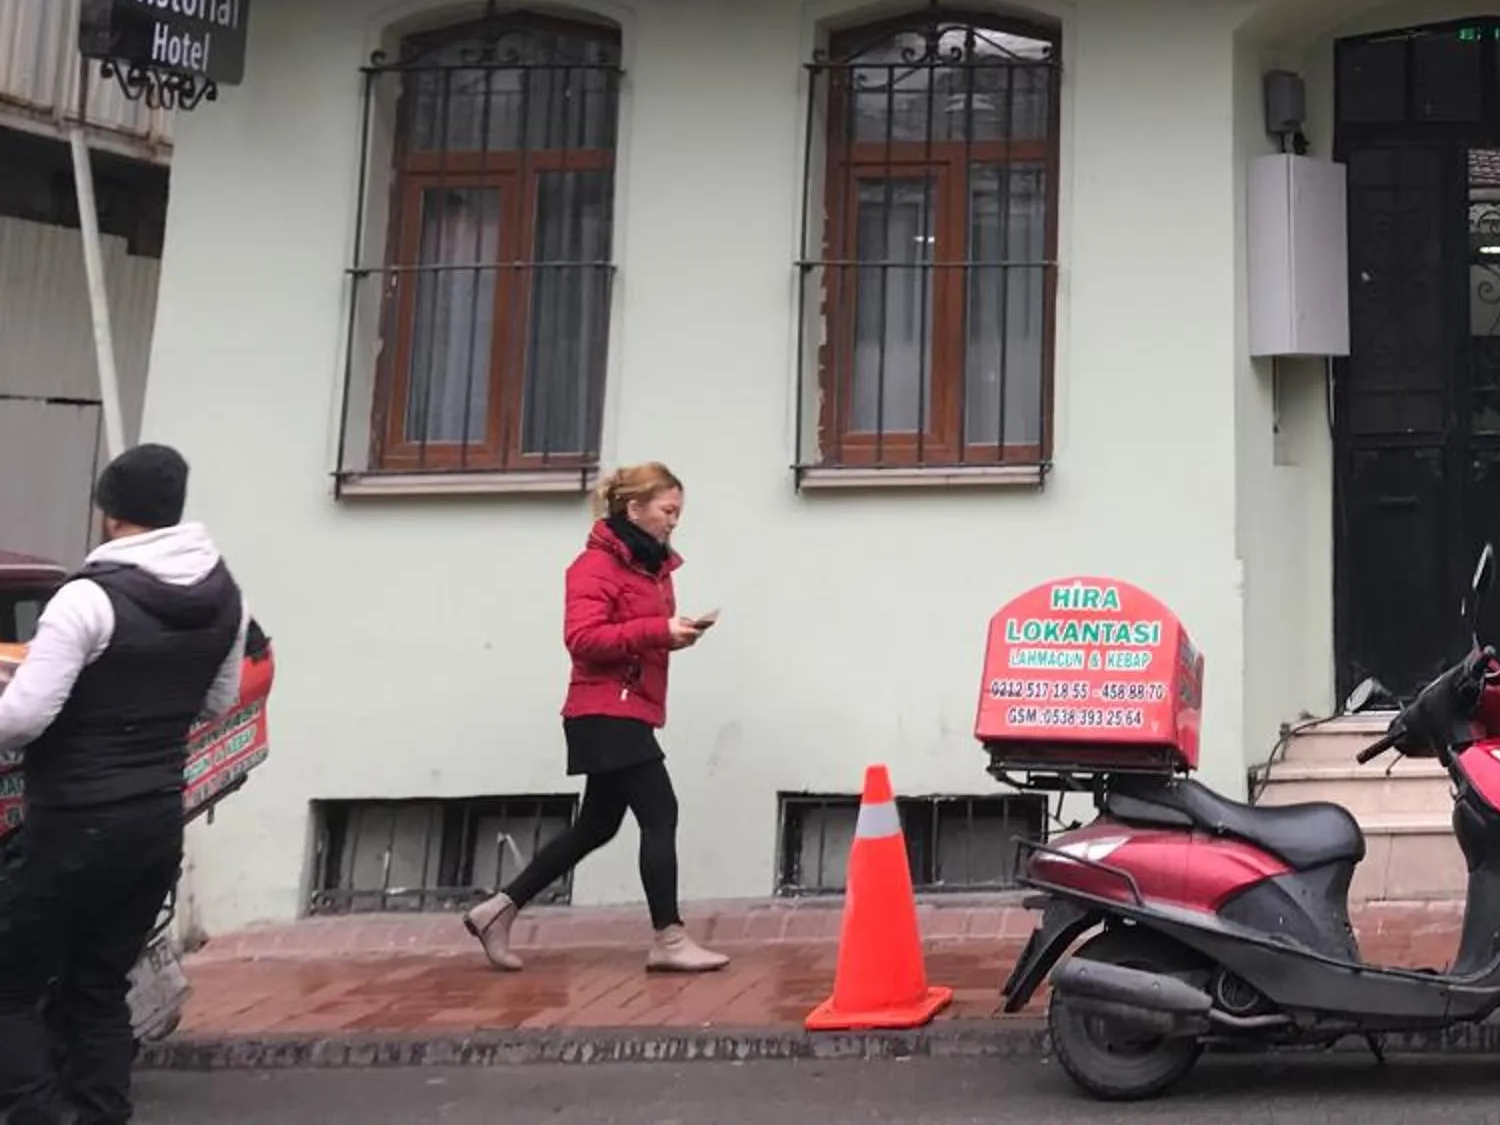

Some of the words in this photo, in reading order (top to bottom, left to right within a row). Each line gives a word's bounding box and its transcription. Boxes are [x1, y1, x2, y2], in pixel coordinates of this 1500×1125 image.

[152, 22, 210, 72] Hotel
[1006, 620, 1160, 645] LOKANTASI
[1010, 649, 1083, 668] LAHMACUN
[1089, 651, 1100, 668] &
[1106, 651, 1152, 669] KEBAP
[991, 680, 1023, 698] 0212
[1026, 681, 1049, 698] 517
[1053, 682, 1068, 699] 18
[1072, 683, 1088, 699] 55
[1101, 683, 1125, 700] 458
[1129, 684, 1145, 700] 88
[1149, 684, 1164, 701] 70
[1008, 707, 1037, 724] GSM
[1080, 709, 1103, 725] 393
[1106, 711, 1122, 726] 25
[1125, 711, 1141, 726] 64
